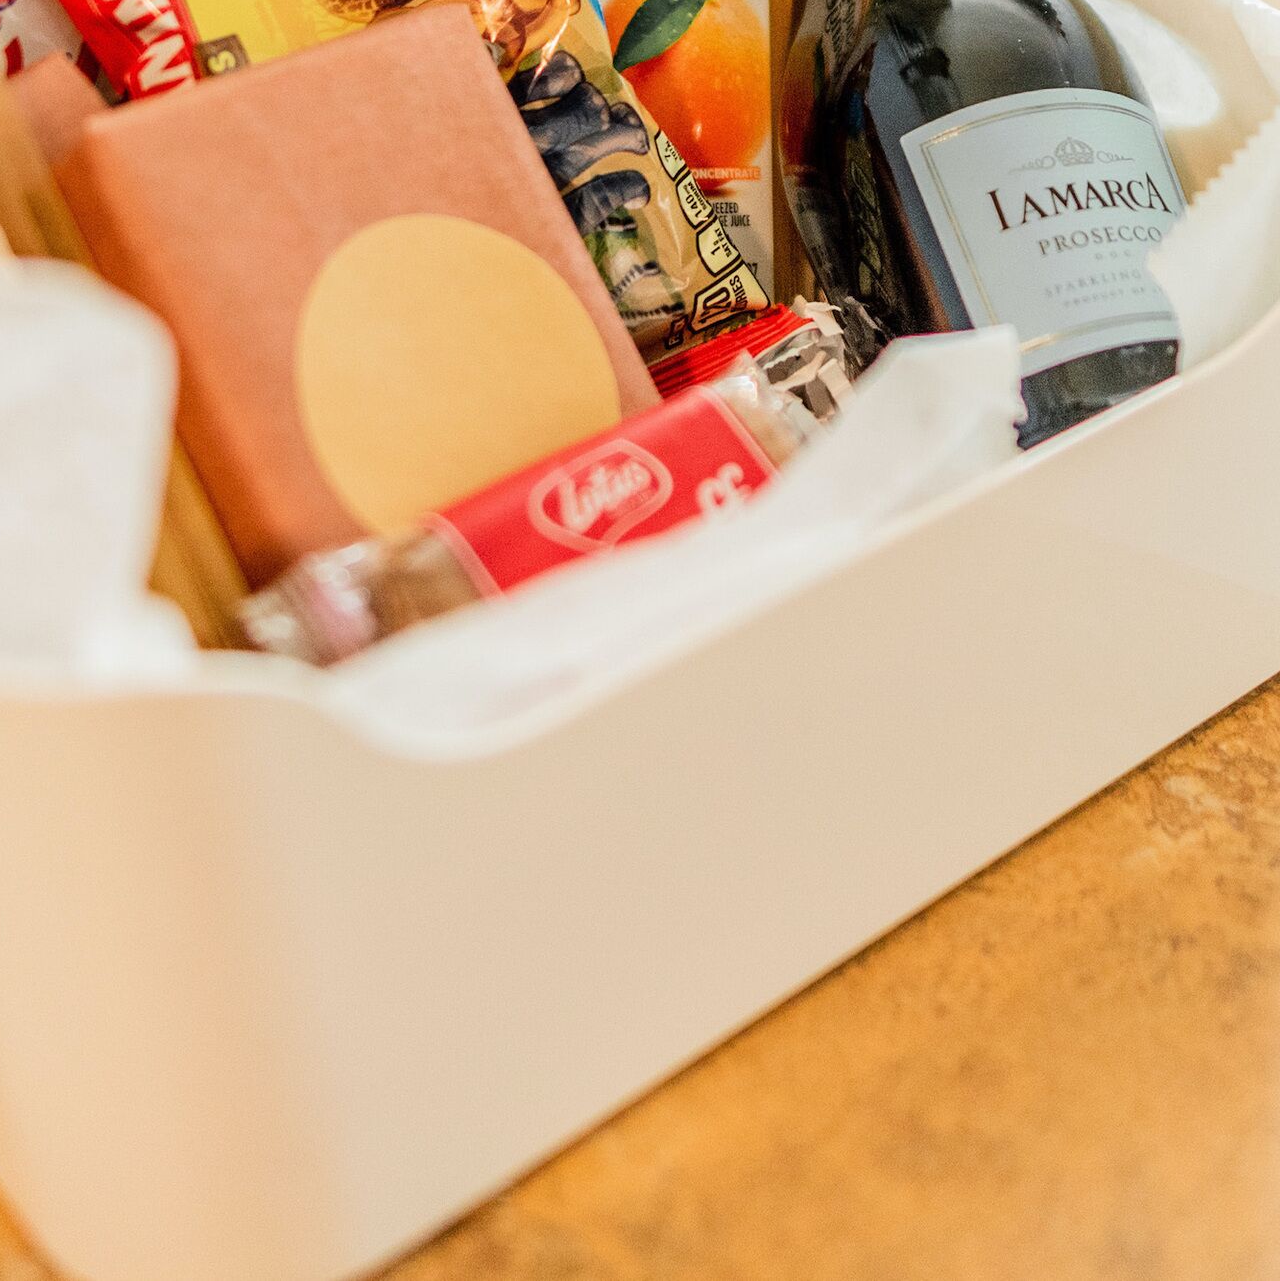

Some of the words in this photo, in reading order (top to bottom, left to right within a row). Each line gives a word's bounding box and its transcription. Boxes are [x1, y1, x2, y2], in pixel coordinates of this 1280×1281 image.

[691, 167, 761, 181] ONCENTRATE
[731, 214, 751, 227] JUICE
[1037, 225, 1163, 256] PROSECCO
